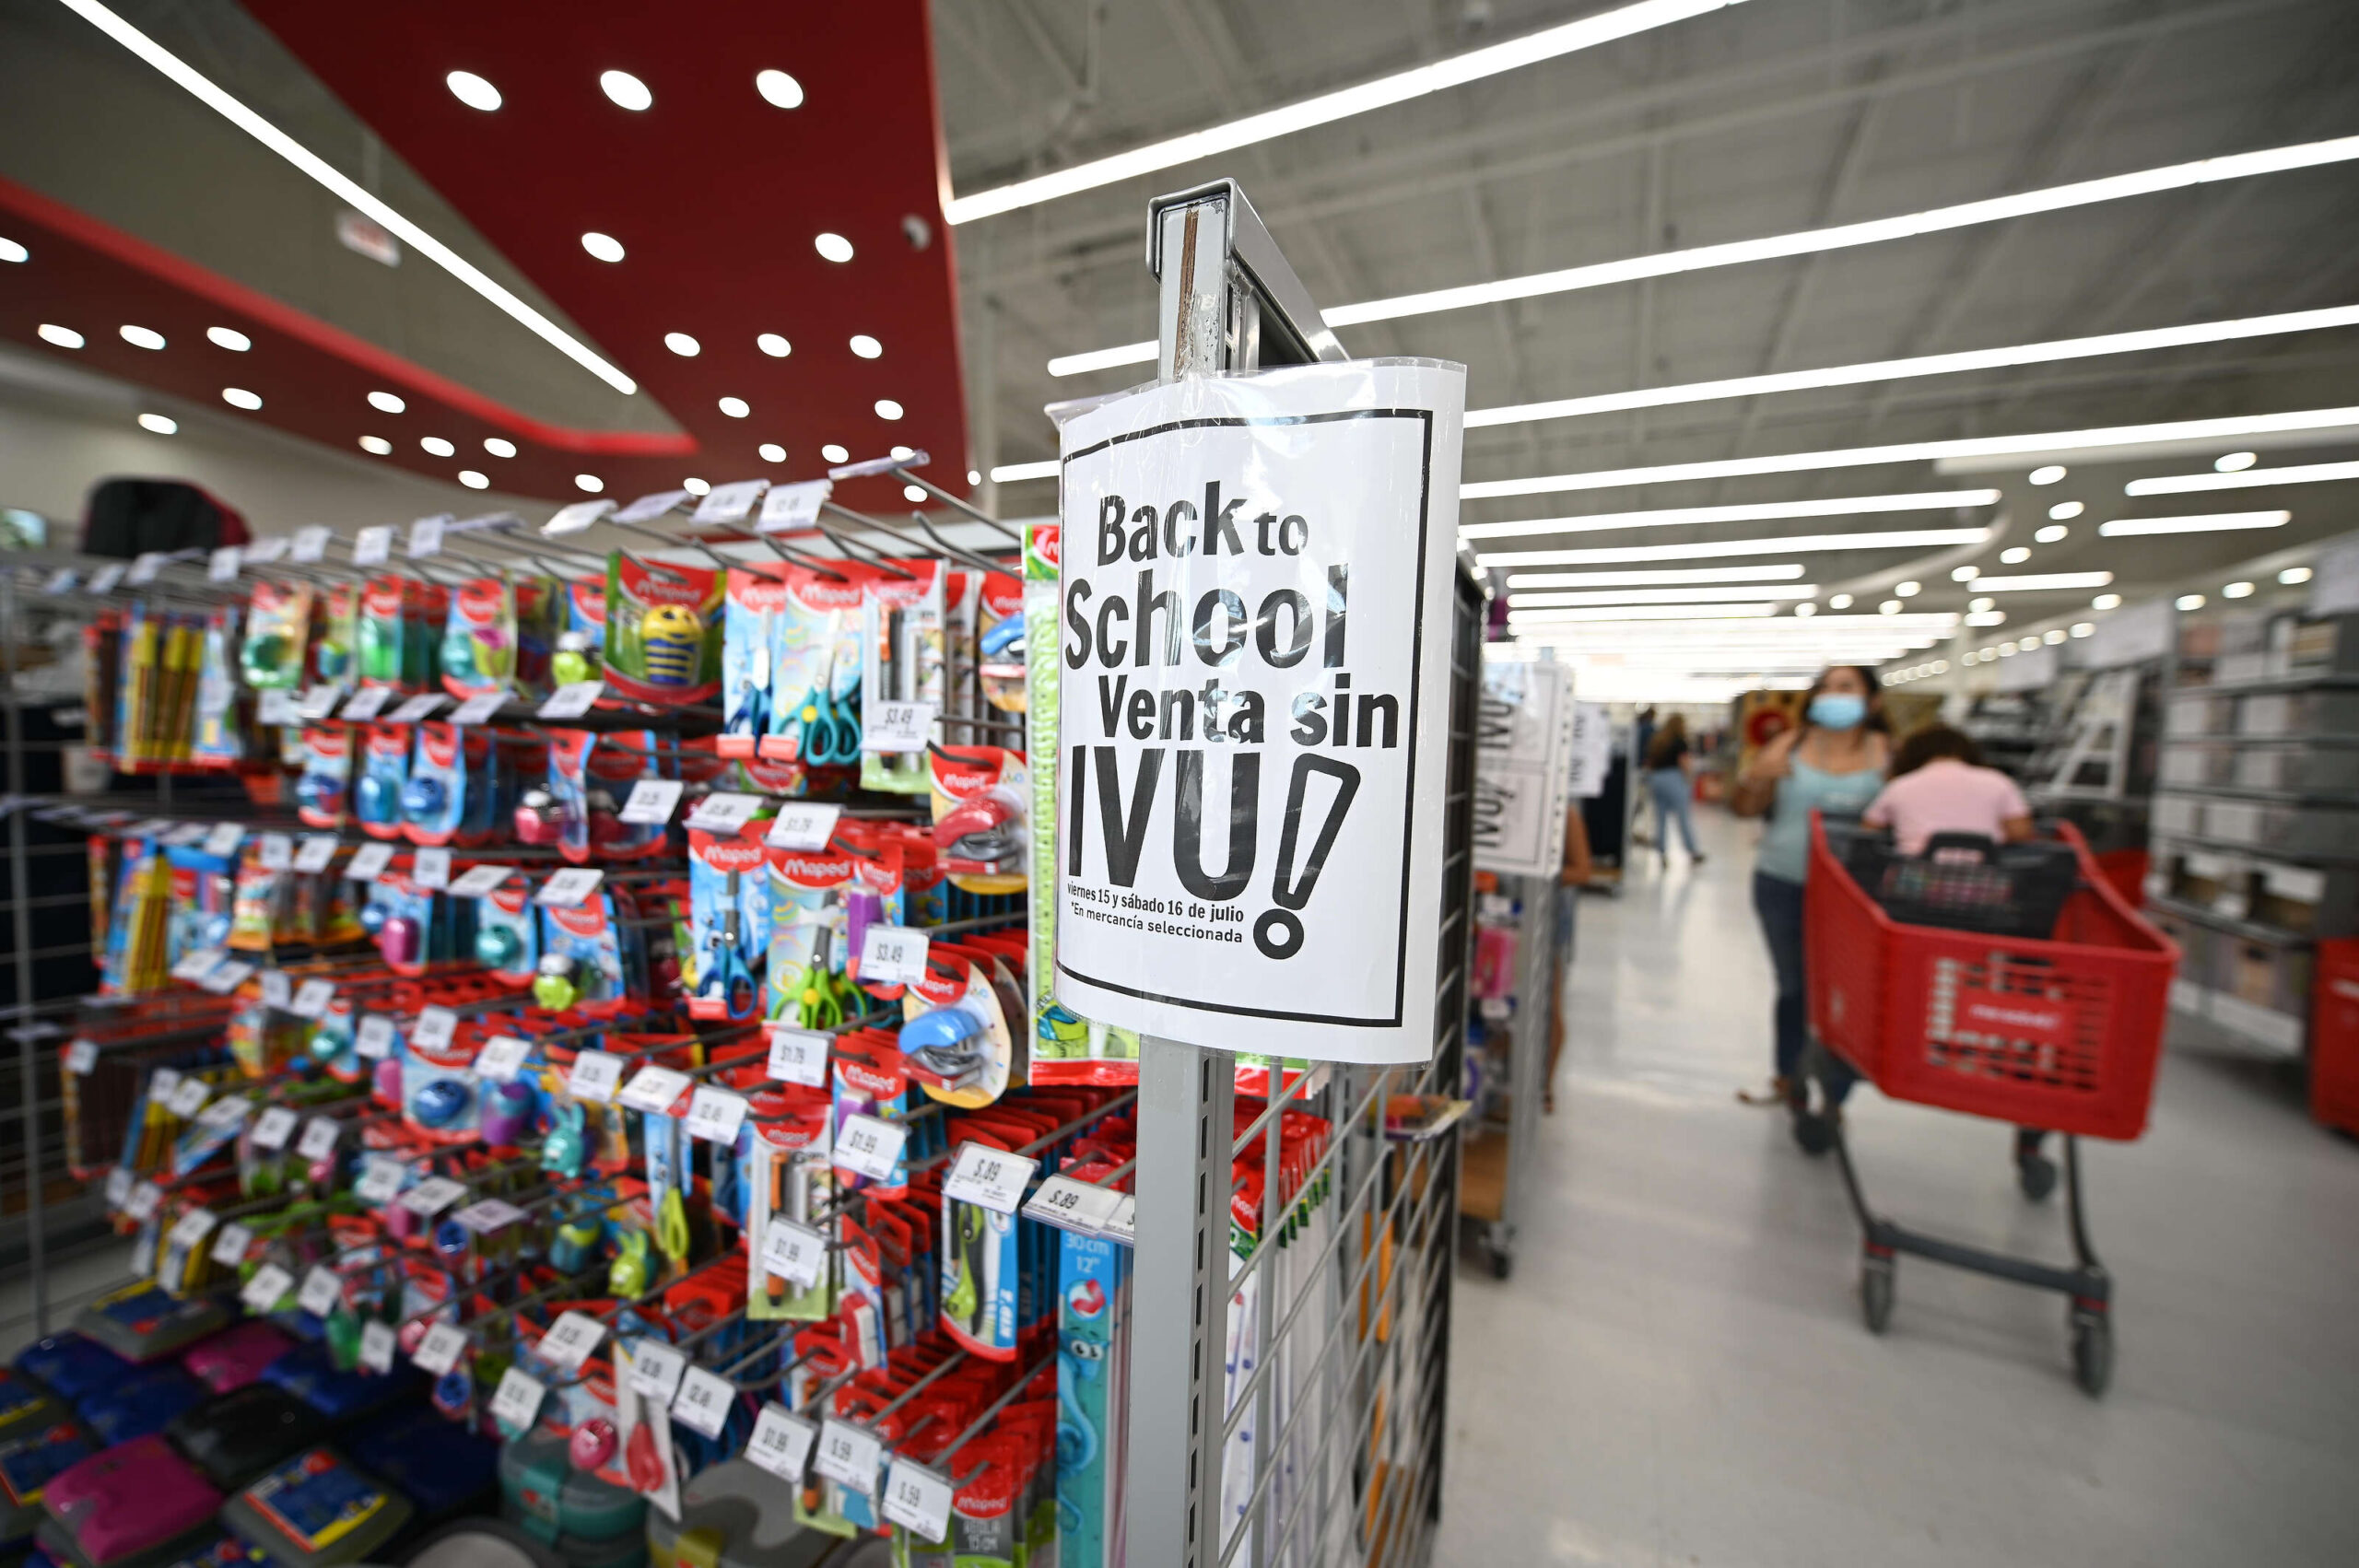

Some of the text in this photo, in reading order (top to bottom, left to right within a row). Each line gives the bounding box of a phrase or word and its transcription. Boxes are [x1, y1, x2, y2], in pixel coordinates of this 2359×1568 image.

[1097, 481, 1309, 567] Back to
[1065, 563, 1348, 670] School
[1098, 673, 1399, 748] Venta sin
[783, 859, 851, 880] Maped
[1067, 882, 1244, 922] viernes 15 y sábado 16 de julio
[1086, 908, 1144, 930] mercancía
[1147, 921, 1242, 942] seleccionada
[973, 1158, 1002, 1182] $.89
[1049, 1189, 1080, 1210] $.89
[1065, 1232, 1084, 1250] 30
